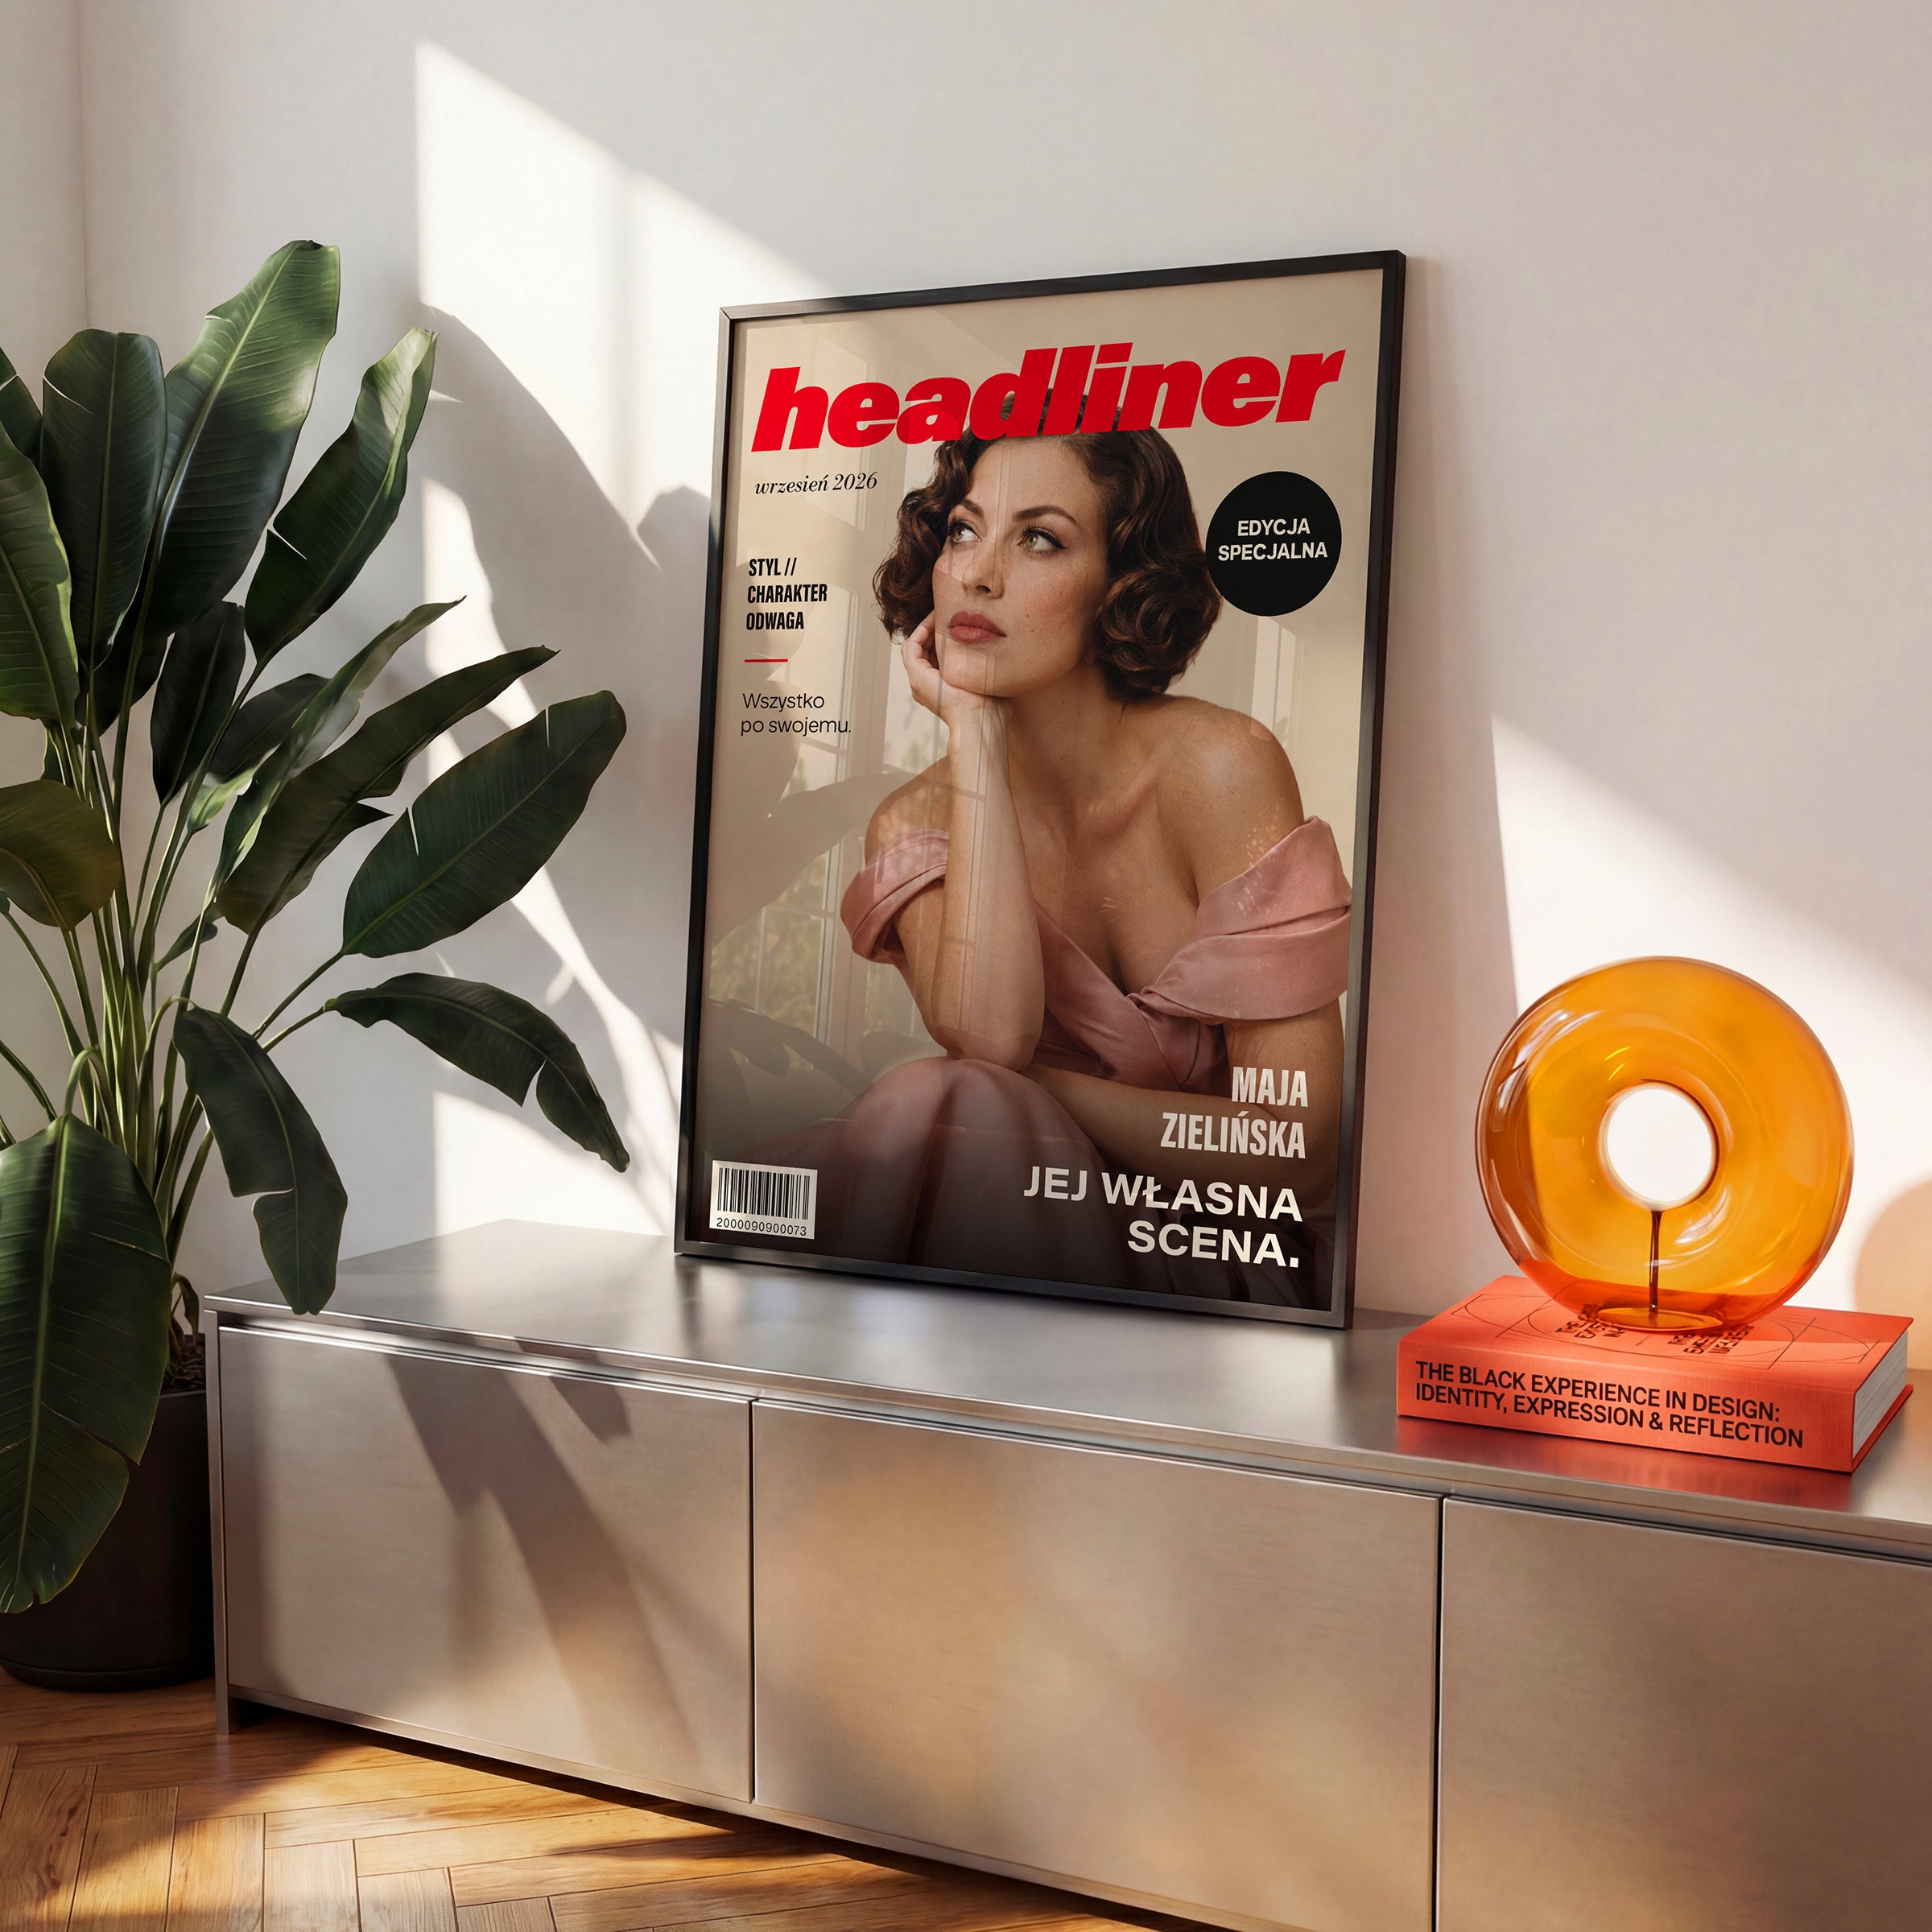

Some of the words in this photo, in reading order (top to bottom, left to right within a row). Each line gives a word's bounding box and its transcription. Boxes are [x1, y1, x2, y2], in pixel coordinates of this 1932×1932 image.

[750, 342, 1347, 452] headliner
[754, 473, 829, 495] wrzesień
[832, 471, 878, 491] 2026
[1237, 518, 1311, 537] EDYCJA
[1218, 542, 1328, 561] SPECJALNA
[748, 558, 782, 576] STYL
[747, 584, 828, 604] CHARAKTER
[746, 612, 804, 630] ODWAGA
[742, 692, 825, 712] Wszystko
[741, 718, 764, 737] po
[768, 717, 852, 737] swojemu.
[1231, 1067, 1308, 1107] MAJA
[1160, 1111, 1306, 1159] ZIELIŃSKA
[1023, 1166, 1088, 1202] JEJ
[1101, 1172, 1303, 1223] WŁASNA
[716, 1217, 807, 1236] 2000090900073
[1128, 1220, 1299, 1269] SCENA.
[1415, 1360, 1454, 1382] THE
[1459, 1366, 1526, 1391] BLACK
[1531, 1374, 1660, 1407] EXPERIENCE
[1666, 1390, 1686, 1410] IN
[1692, 1393, 1780, 1422] DESIGN:
[1416, 1382, 1508, 1414] IDENTITY,
[1513, 1394, 1644, 1428] EXPRESSION
[1649, 1412, 1664, 1430] &
[1670, 1414, 1803, 1448] REFLECTION
